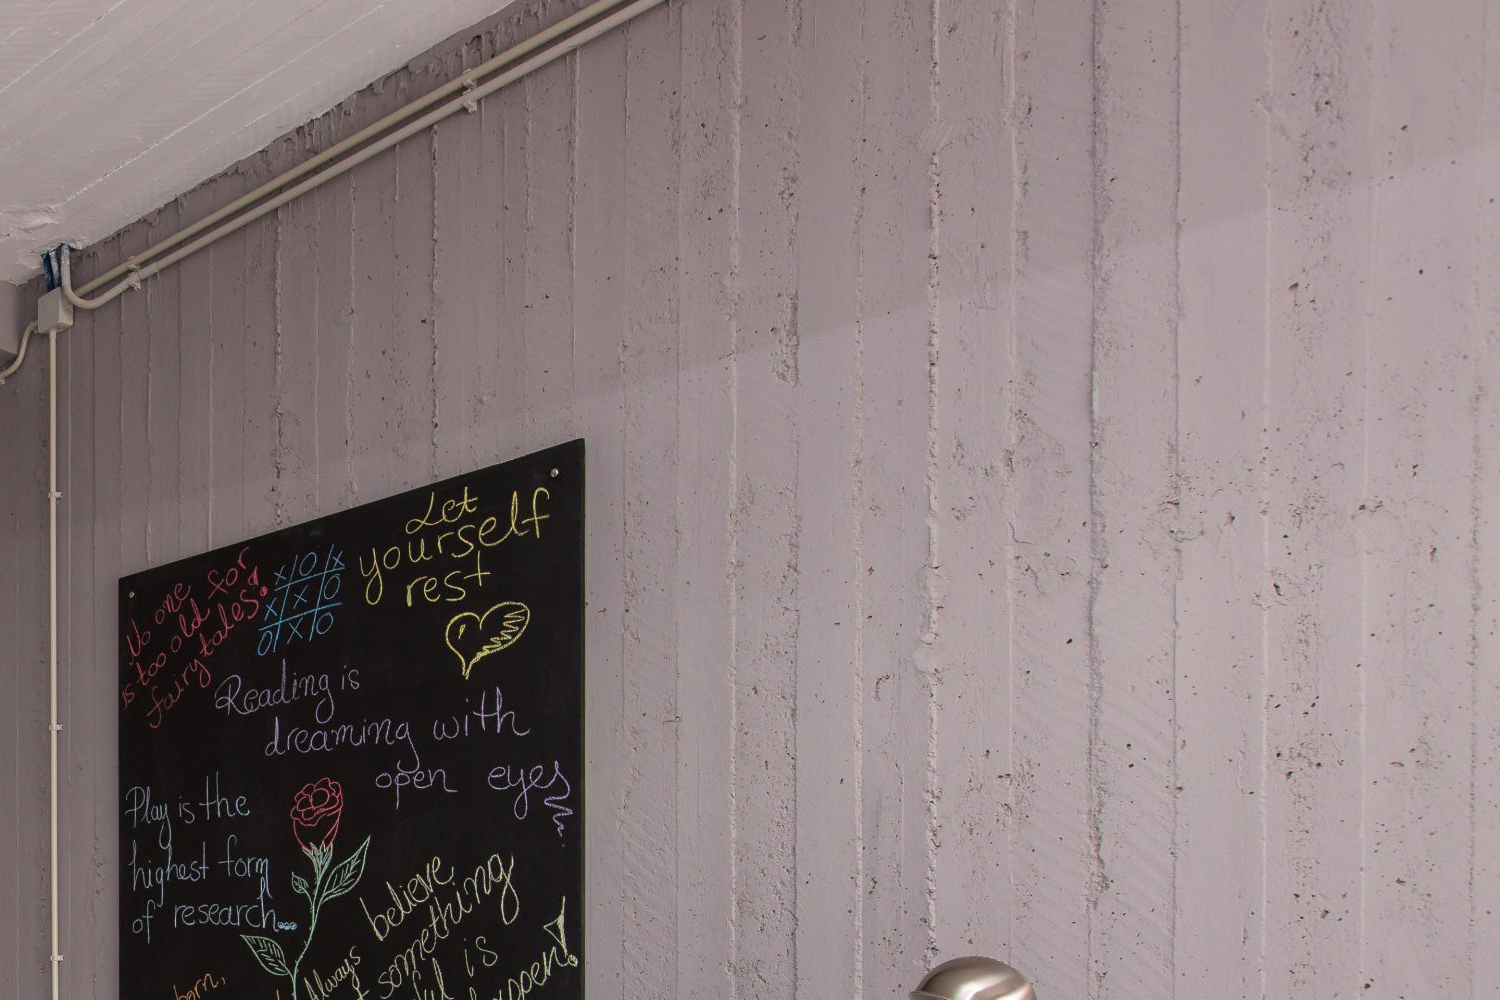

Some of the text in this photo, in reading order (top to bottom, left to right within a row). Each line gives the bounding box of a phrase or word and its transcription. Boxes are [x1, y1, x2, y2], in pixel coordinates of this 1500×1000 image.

[359, 487, 550, 606] yourself
[405, 486, 479, 535] Let
[155, 583, 191, 625] one
[207, 546, 250, 600] for
[406, 550, 492, 607] rest
[136, 652, 167, 686] too
[170, 598, 211, 653] old
[147, 659, 212, 729] fairy
[215, 658, 360, 724] Reading is
[264, 686, 531, 774] dreaming with
[124, 770, 251, 850] Play is the
[375, 767, 458, 810] open
[128, 834, 274, 908] highest form
[359, 855, 455, 942] believe
[132, 899, 156, 945] of
[377, 853, 520, 1000] something
[463, 935, 498, 978] is
